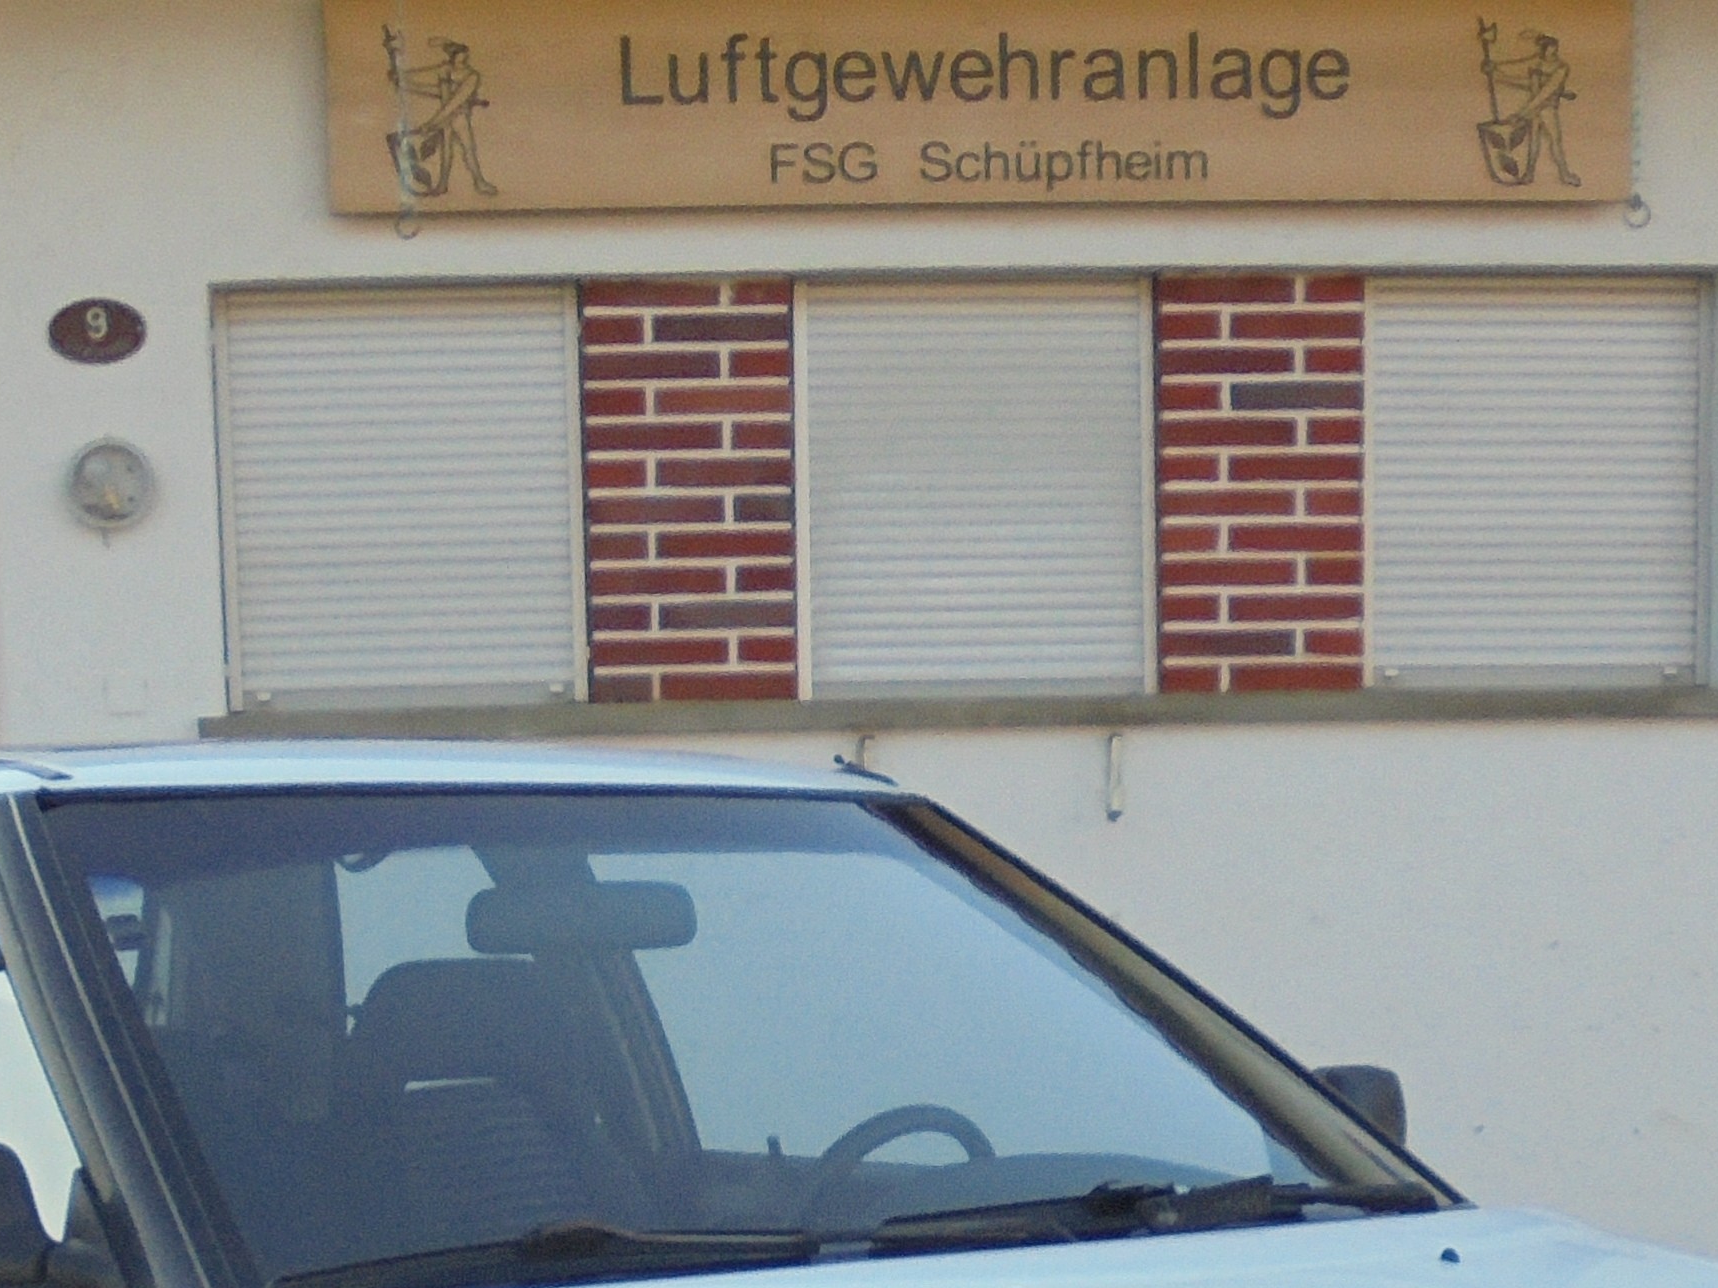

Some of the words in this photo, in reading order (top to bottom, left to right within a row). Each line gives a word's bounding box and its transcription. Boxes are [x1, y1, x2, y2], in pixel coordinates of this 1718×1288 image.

[619, 32, 1350, 122] Luftgewehranlage
[770, 141, 879, 183] FSG
[919, 139, 1209, 190] Schüpfheim
[87, 307, 108, 340] 9
